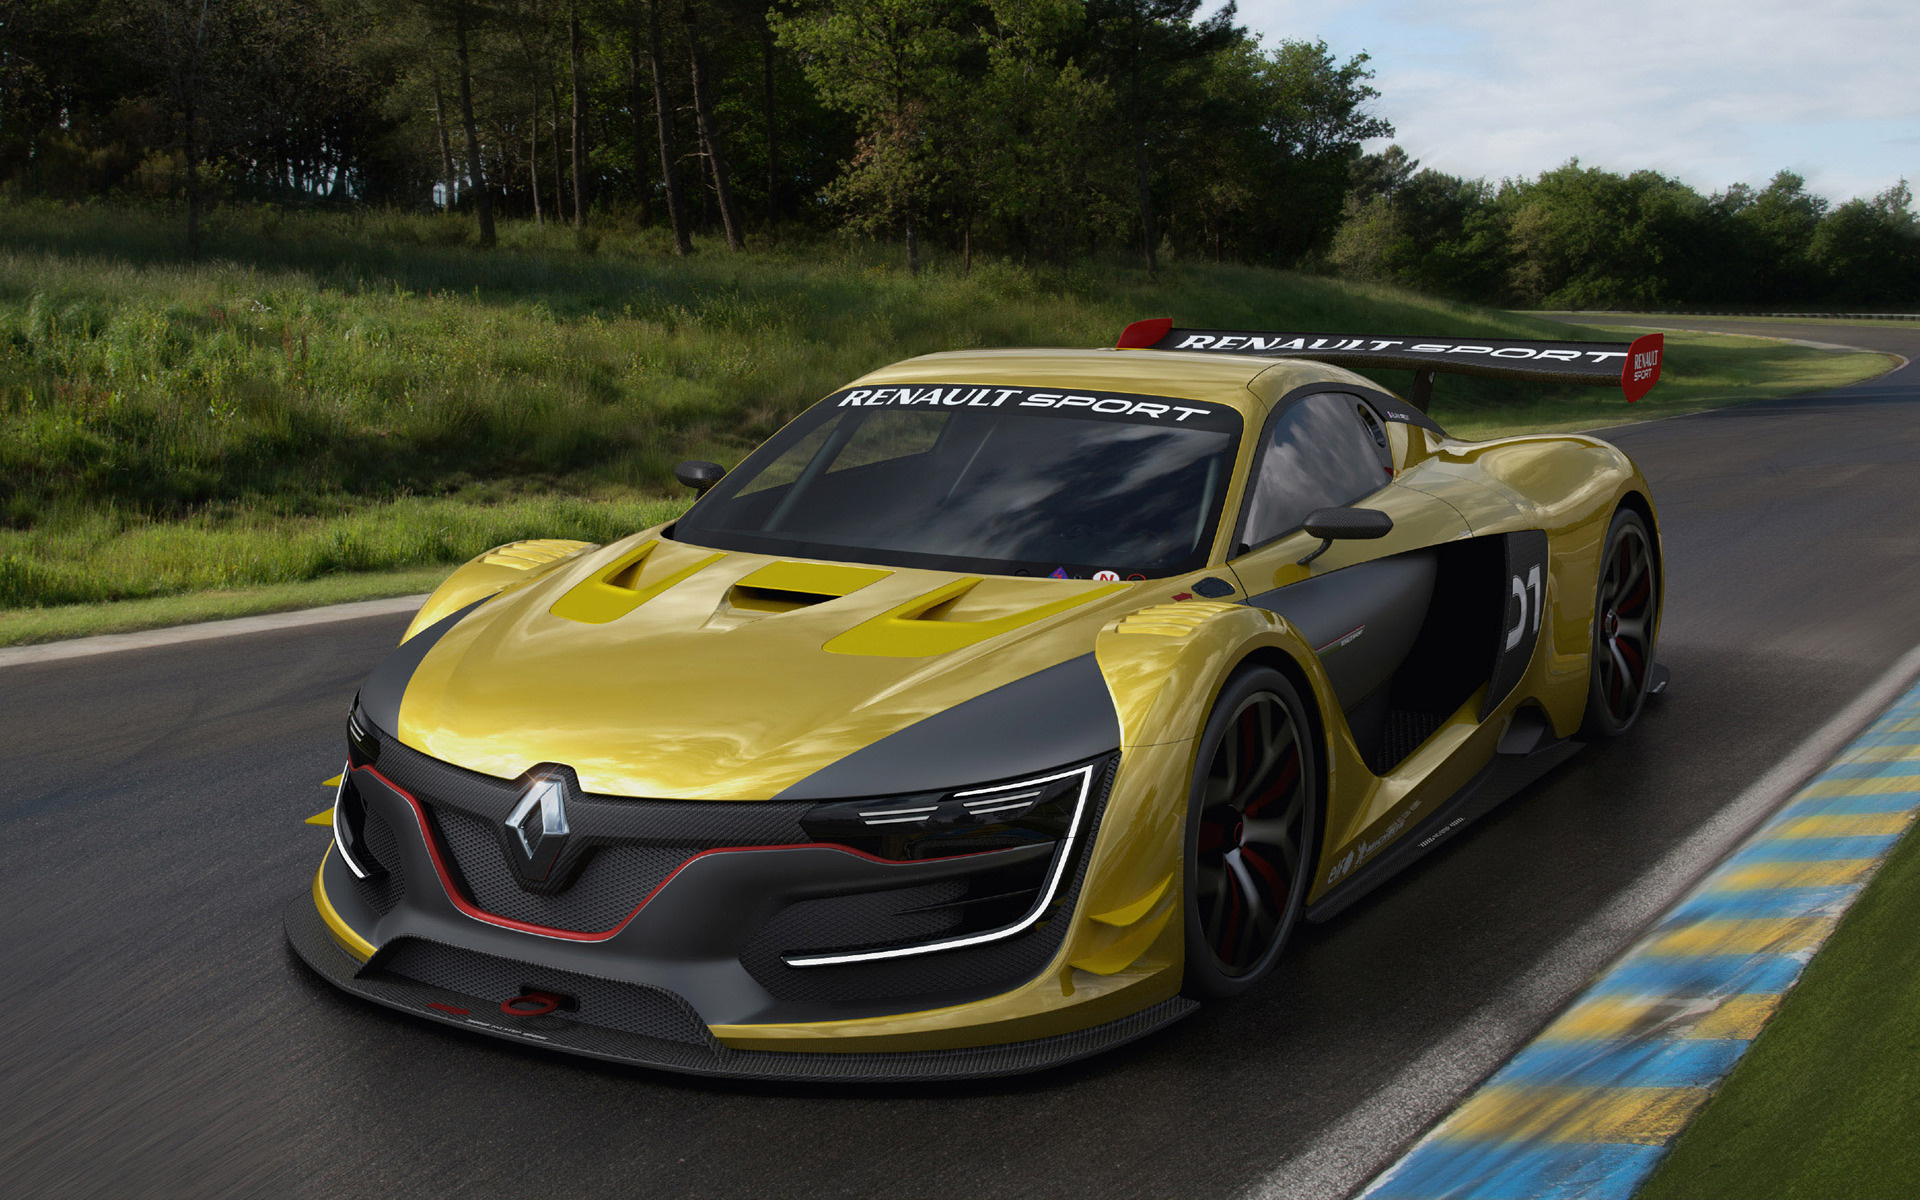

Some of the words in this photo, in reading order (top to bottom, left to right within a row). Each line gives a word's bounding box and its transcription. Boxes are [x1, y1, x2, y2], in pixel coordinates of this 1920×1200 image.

[1175, 334, 1404, 352] RENAULT
[1402, 343, 1629, 364] SPORT
[1634, 350, 1659, 370] RENAULT
[1633, 368, 1653, 382] SPORT
[838, 388, 1022, 407] RENAULT
[1019, 393, 1212, 422] SPORT
